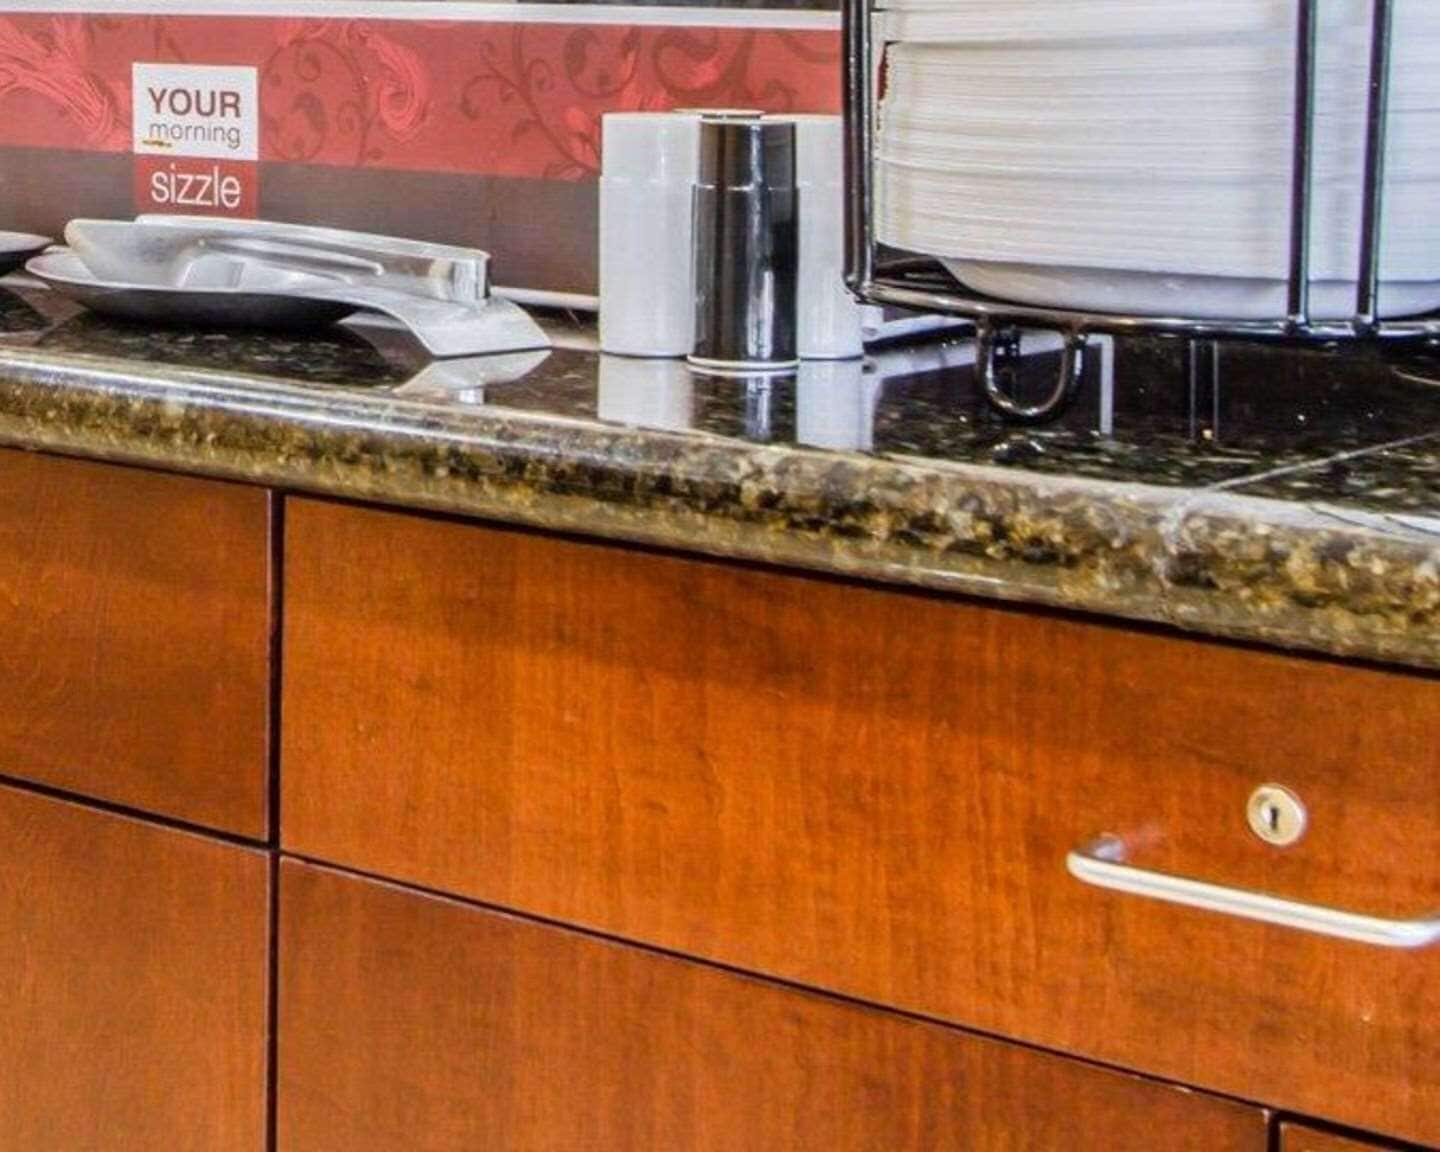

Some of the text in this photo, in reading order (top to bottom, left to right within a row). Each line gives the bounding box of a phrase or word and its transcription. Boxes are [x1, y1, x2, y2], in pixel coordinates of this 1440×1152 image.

[148, 87, 241, 118] YOUR
[149, 122, 241, 150] morning
[151, 162, 241, 208] sizzle
